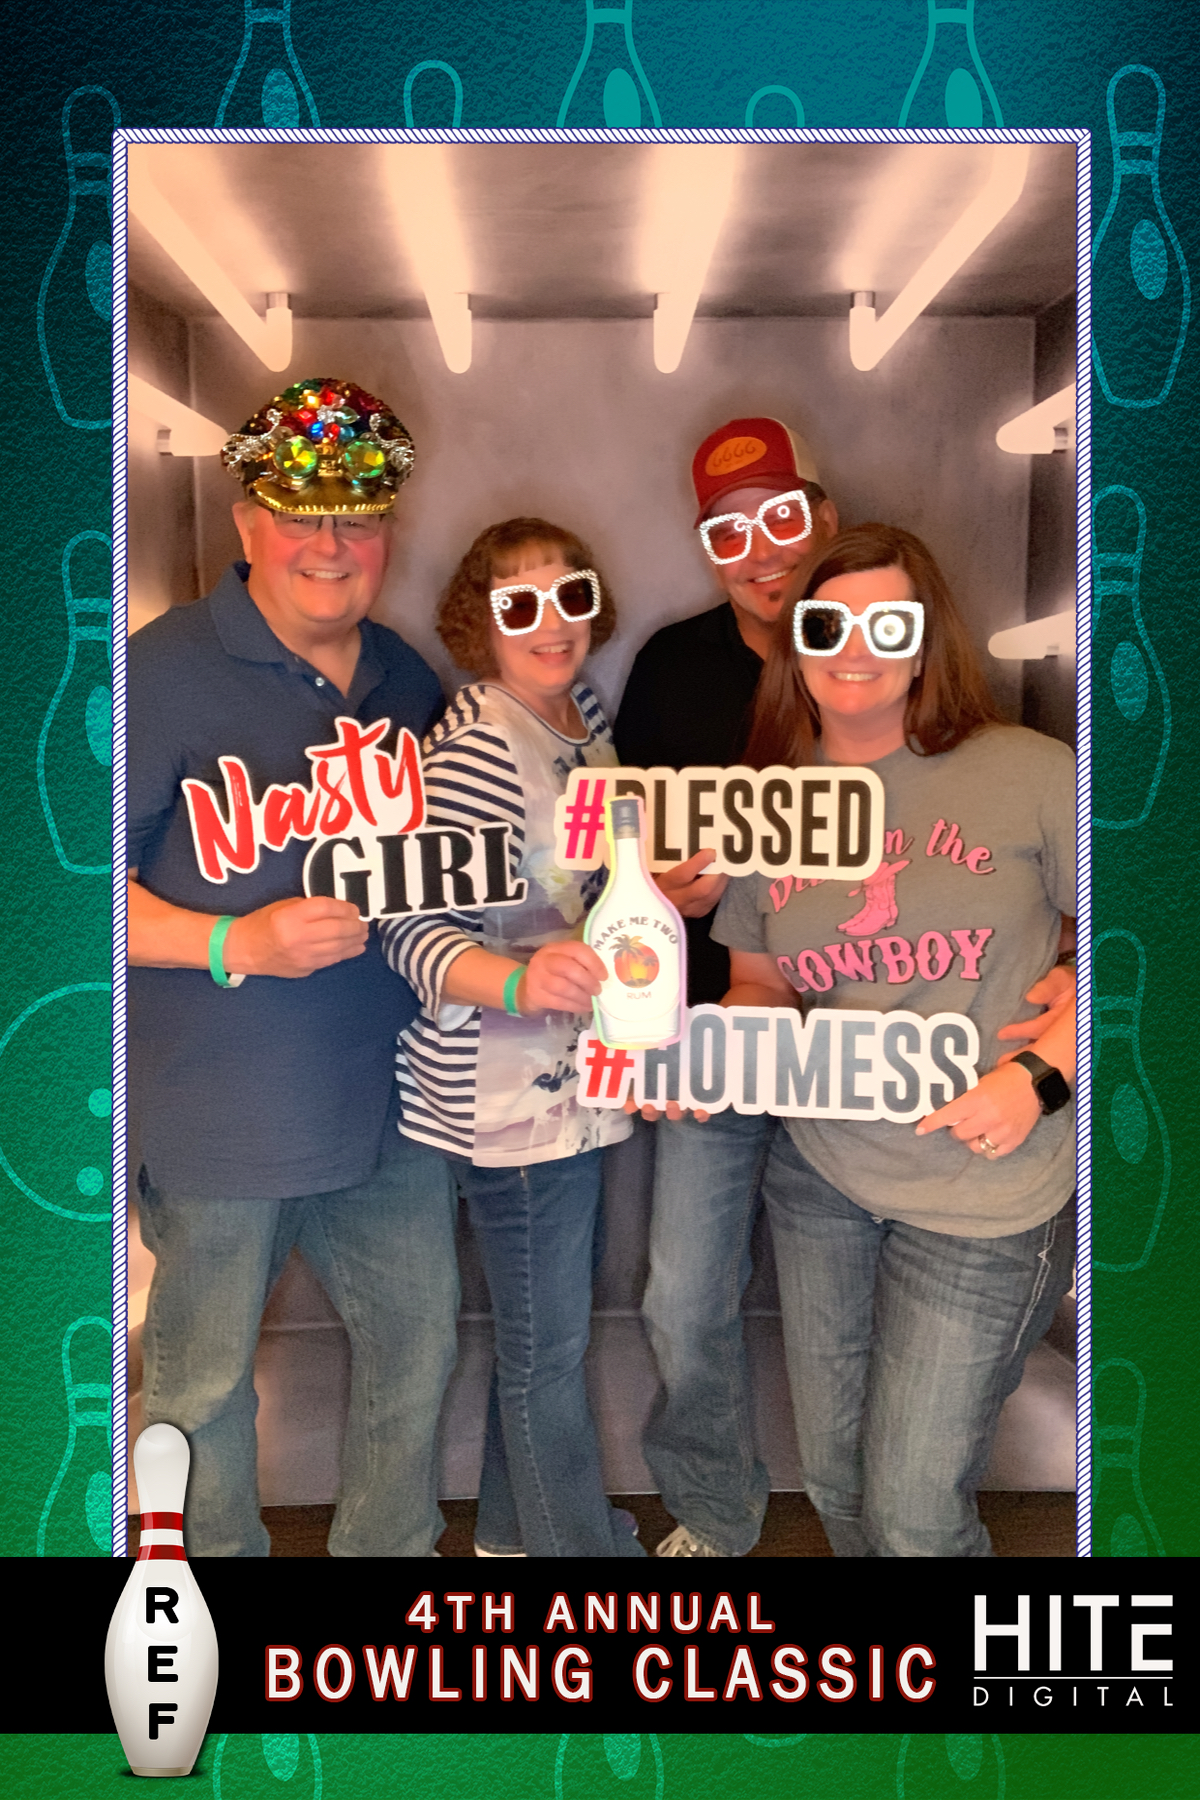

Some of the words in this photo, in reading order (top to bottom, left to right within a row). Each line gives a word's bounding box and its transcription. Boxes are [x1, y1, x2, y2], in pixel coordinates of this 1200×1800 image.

[186, 721, 425, 880] Nasty
[308, 826, 526, 918] GIRL
[883, 828, 914, 855] n
[925, 818, 994, 874] the
[593, 919, 627, 951] MAKE
[629, 916, 649, 927] ME
[652, 918, 679, 945] TWO
[776, 928, 993, 993] COWBOY
[626, 991, 652, 1000] RUM
[585, 1013, 970, 1113] #HOTMESS
